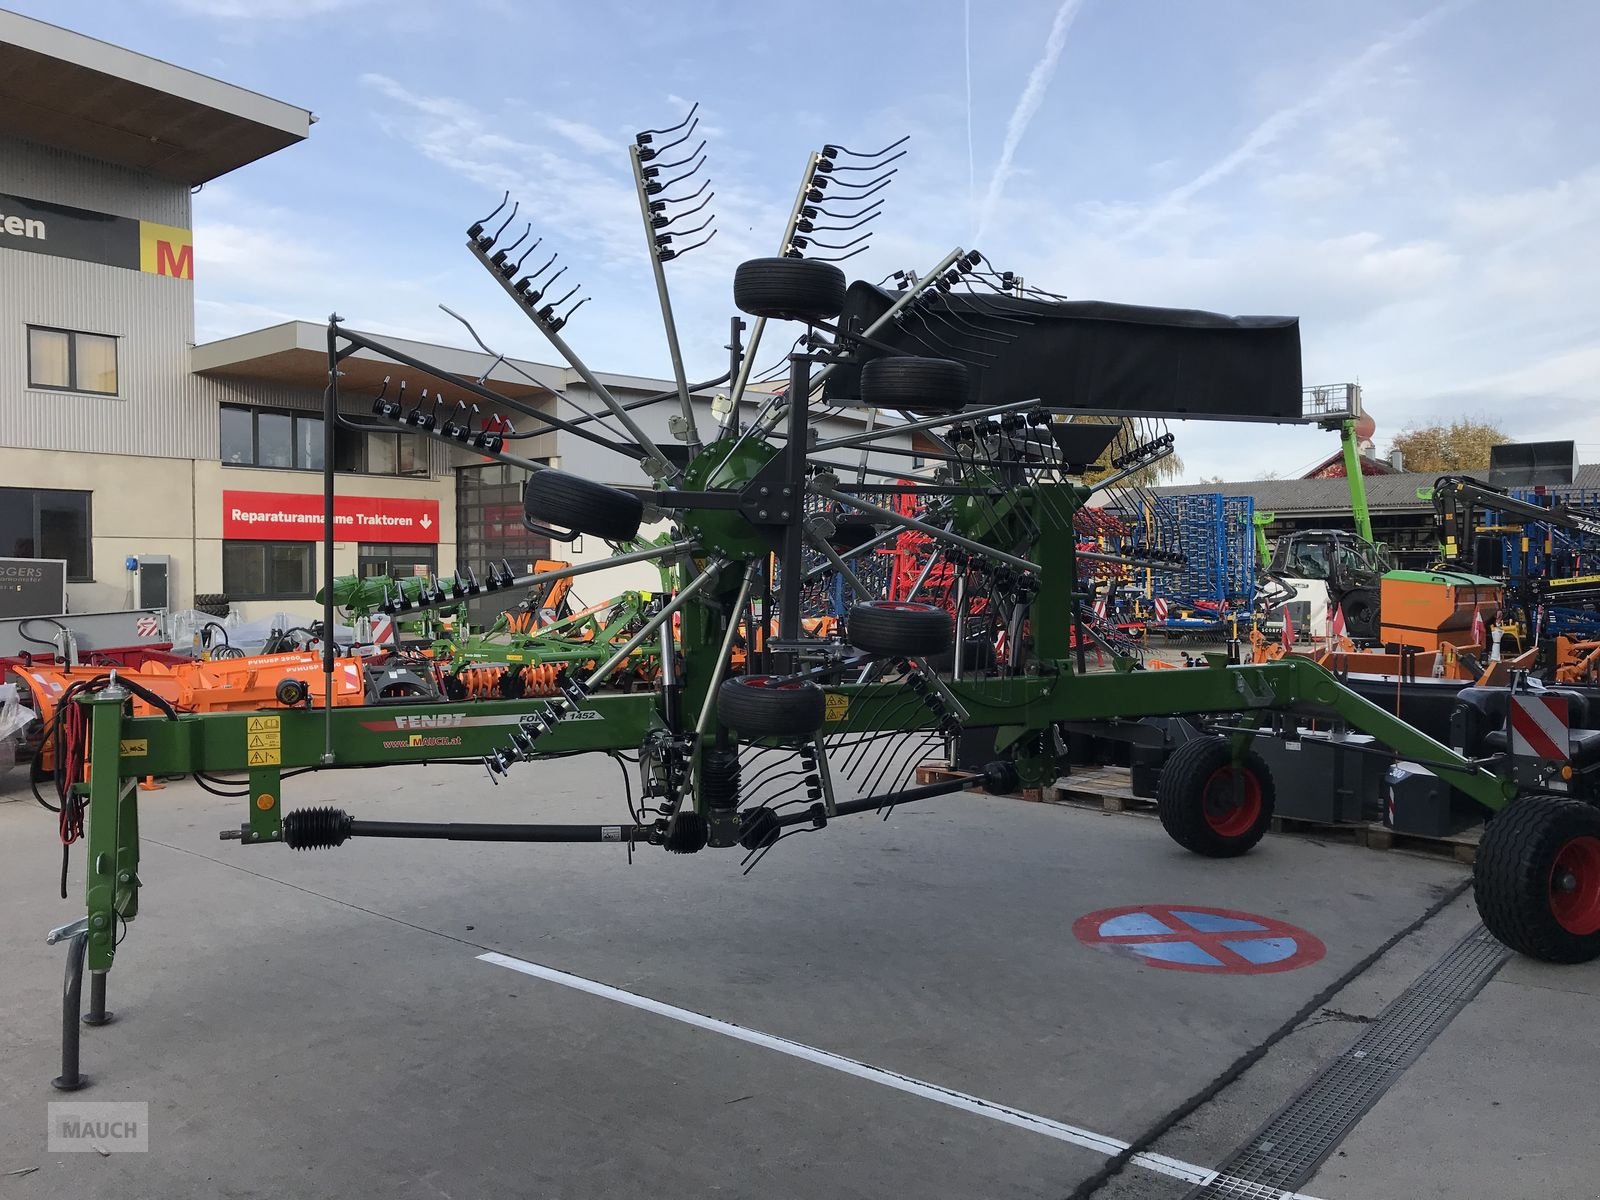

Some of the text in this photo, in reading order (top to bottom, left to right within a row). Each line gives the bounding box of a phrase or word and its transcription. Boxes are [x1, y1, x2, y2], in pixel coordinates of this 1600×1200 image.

[231, 509, 413, 526] Reparaturanname Traktoren
[395, 713, 467, 729] FENDT
[569, 711, 596, 720] 1452
[383, 737, 462, 749] www.MAUCH.at
